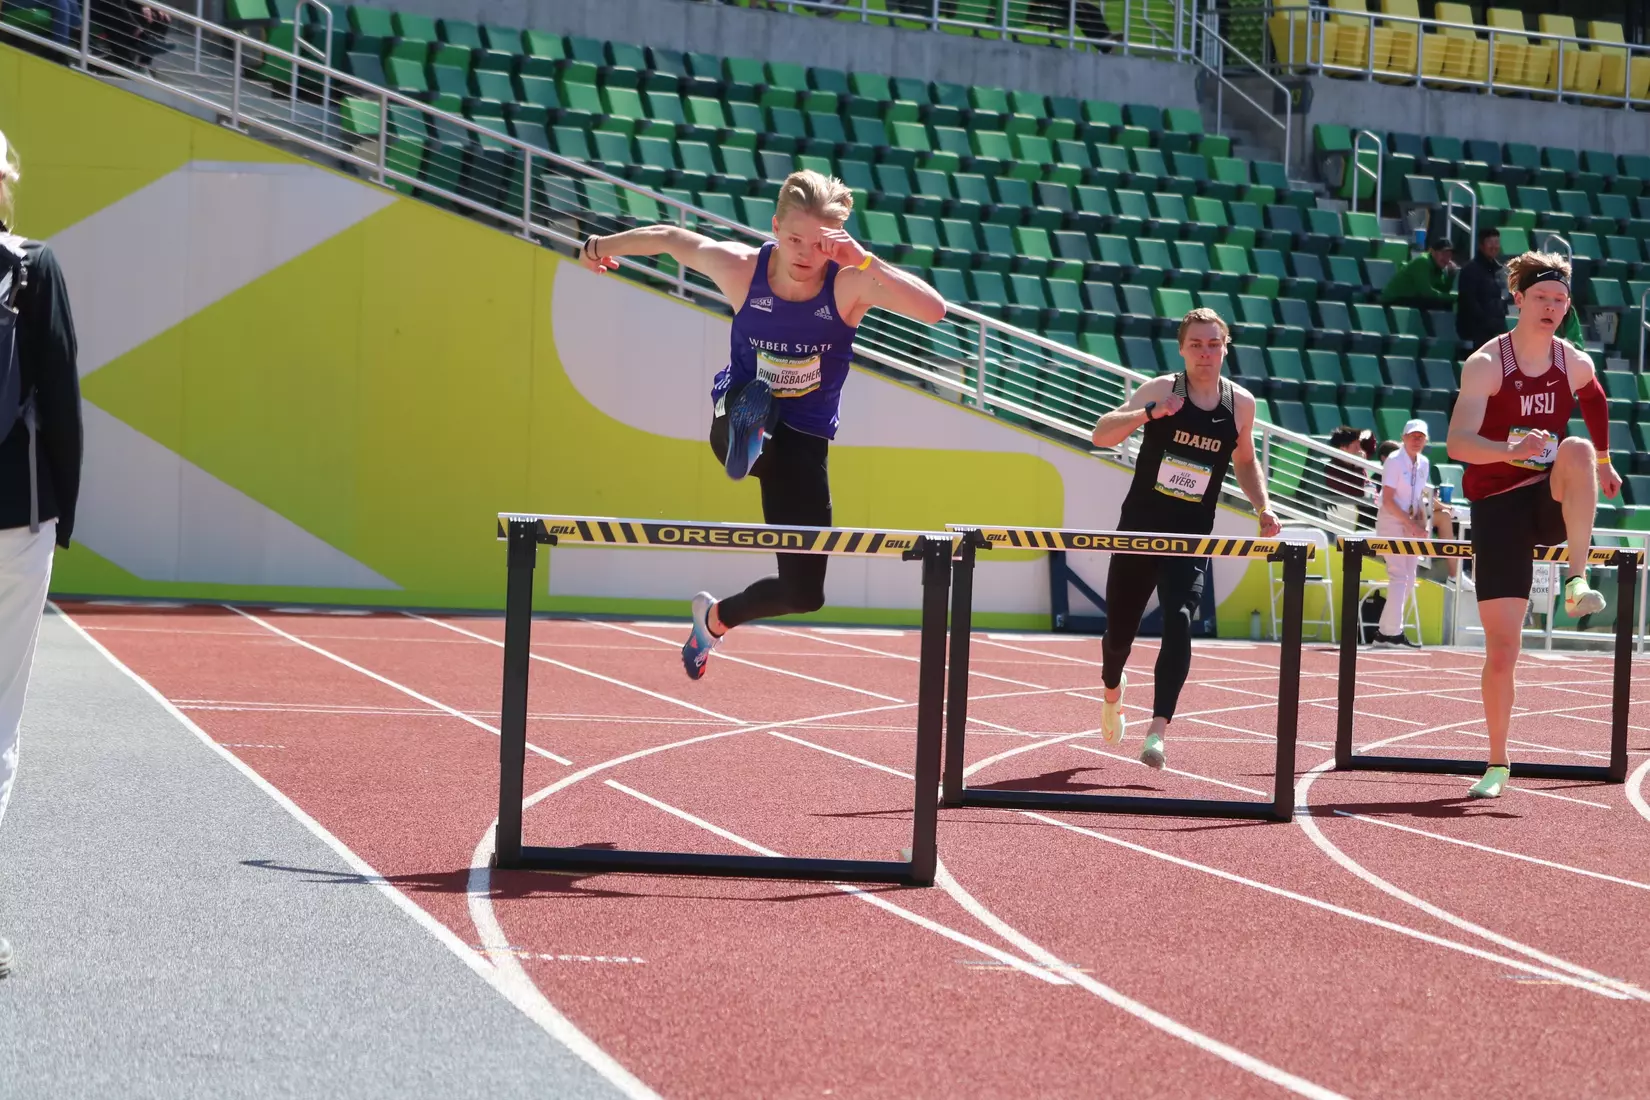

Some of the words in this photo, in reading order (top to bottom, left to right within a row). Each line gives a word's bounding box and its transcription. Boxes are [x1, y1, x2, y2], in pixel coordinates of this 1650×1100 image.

[760, 298, 772, 307] SKY
[749, 337, 788, 351] WEBER
[795, 343, 832, 353] STATE
[758, 367, 821, 384] RINDLISBACHER
[1520, 391, 1555, 416] WSU
[1173, 430, 1221, 452] IDAHO
[1169, 474, 1197, 489] AYERS
[550, 525, 576, 535] GILL
[658, 526, 803, 548] OREGON
[884, 539, 912, 549] GILL
[986, 533, 1008, 542] GILL
[1072, 535, 1189, 552] OREGON
[1253, 545, 1275, 553] GILL
[1592, 552, 1611, 560] GILL
